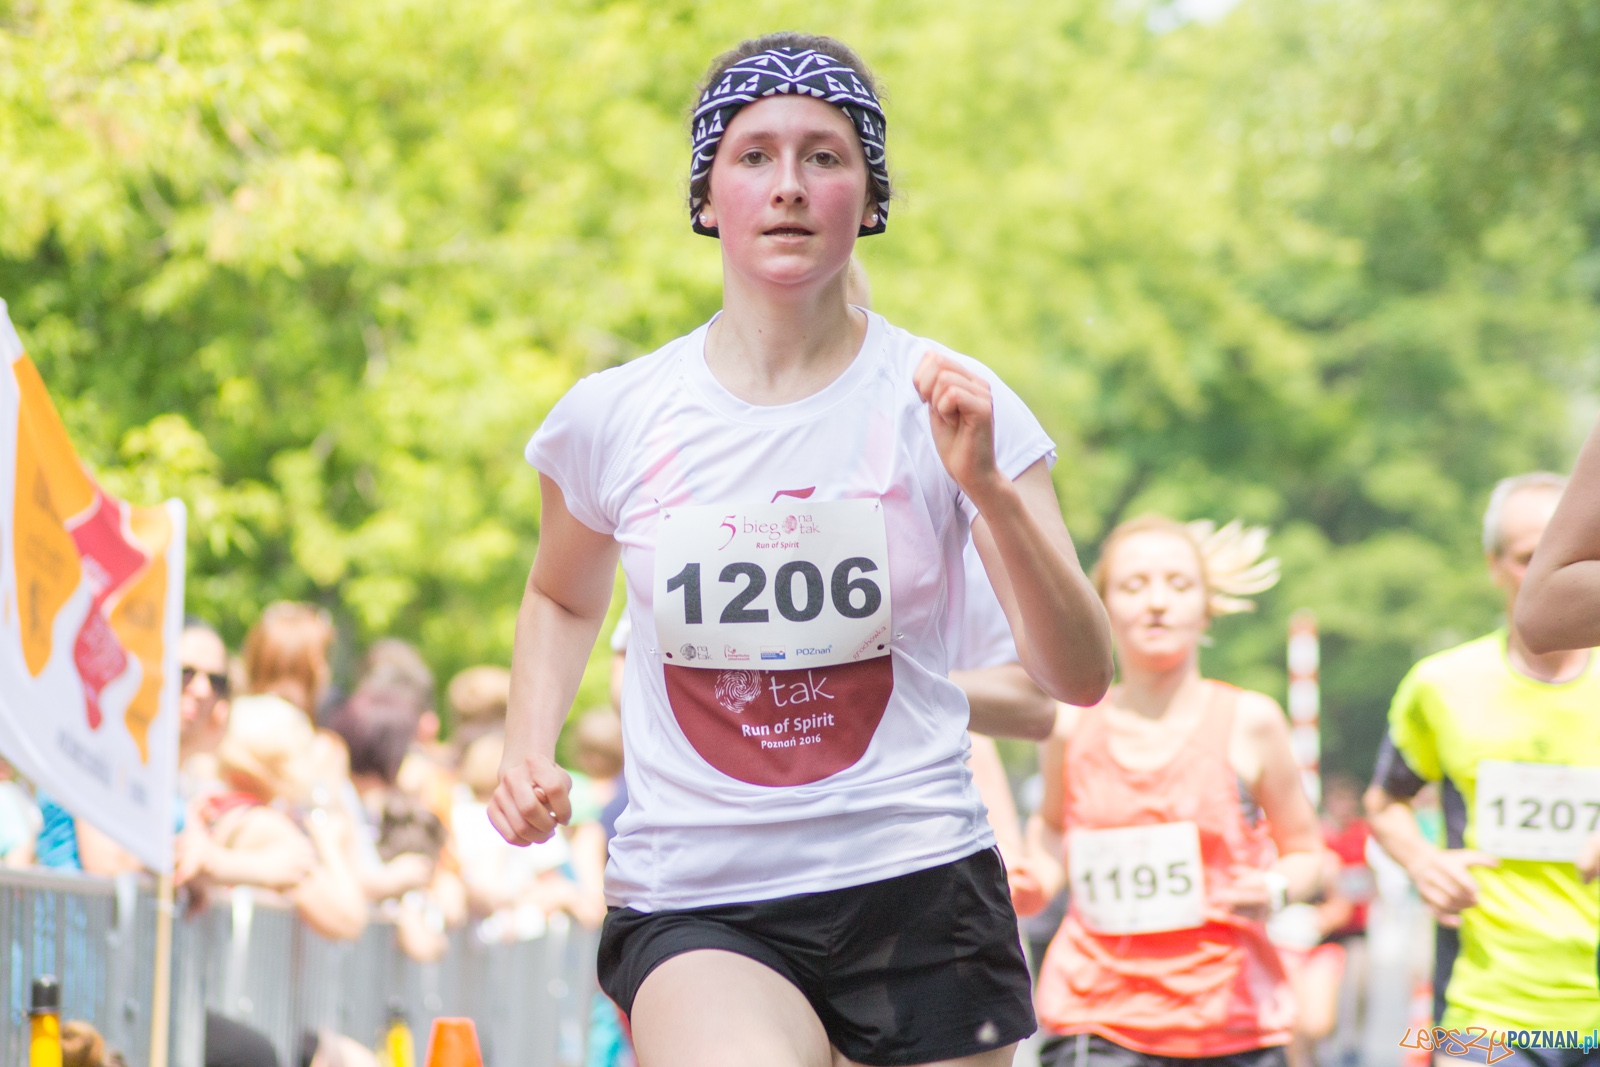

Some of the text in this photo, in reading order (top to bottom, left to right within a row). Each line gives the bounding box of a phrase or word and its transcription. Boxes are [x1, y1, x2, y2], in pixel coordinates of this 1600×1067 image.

[798, 514, 813, 523] na
[799, 522, 821, 535] tak
[718, 514, 782, 551] 5 bieg
[772, 541, 779, 549] of
[780, 541, 800, 550] Spirit
[666, 556, 882, 625] 1206
[697, 651, 712, 660] tak
[769, 670, 835, 707] tak
[741, 712, 835, 737] Run of Spirit
[761, 733, 822, 749] Poznań 2016
[1487, 795, 1600, 833] 1207
[1079, 860, 1193, 903] 1195
